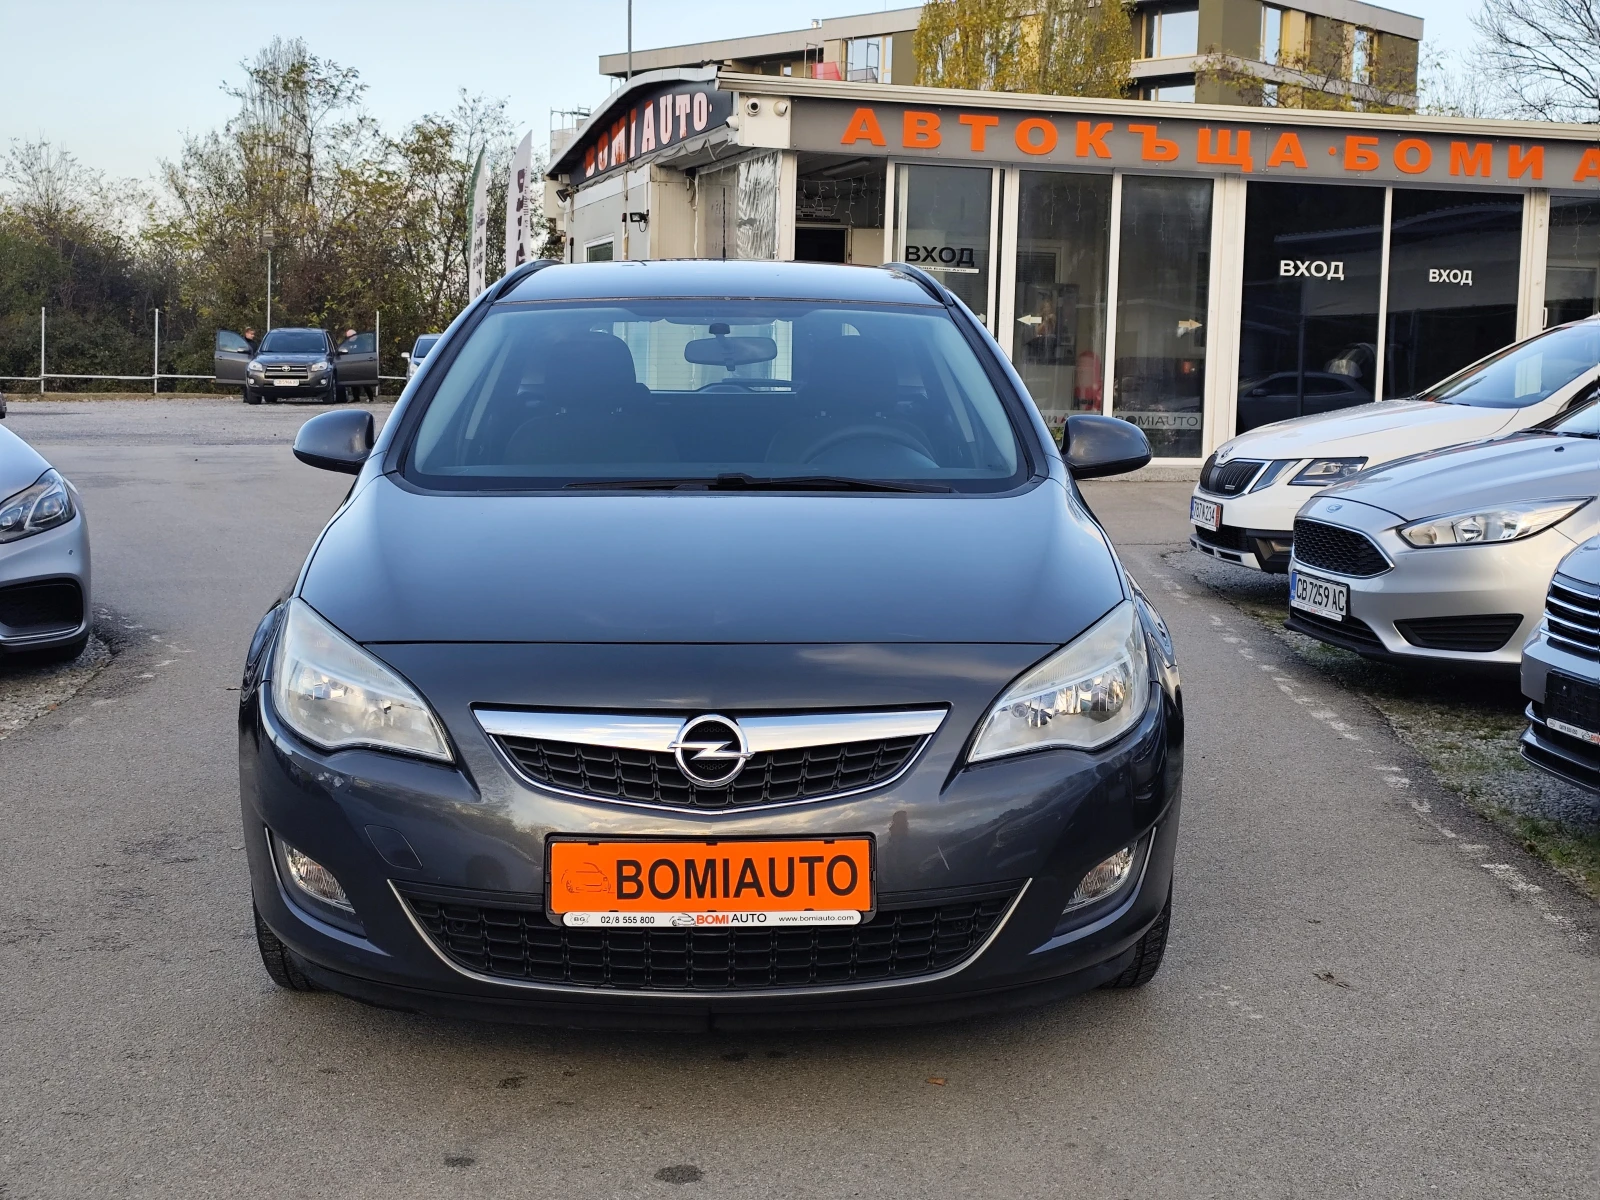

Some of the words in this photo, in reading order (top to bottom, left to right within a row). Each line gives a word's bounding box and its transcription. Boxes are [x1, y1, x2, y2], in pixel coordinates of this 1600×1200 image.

[840, 107, 1309, 173] АВТОКЪЩА
[1344, 135, 1545, 180] БОМИ
[905, 246, 975, 267] ВХОД
[1279, 260, 1345, 281] ВХОД
[1428, 269, 1473, 286] ВХОД
[1308, 582, 1330, 607] 7259
[1332, 588, 1345, 611] AC
[616, 854, 858, 900] BOMIAUTO
[600, 916, 620, 924] 02/8
[622, 915, 638, 924] 555
[639, 915, 655, 924] 800
[696, 914, 729, 925] BOMI
[731, 913, 767, 923] AUTO
[778, 914, 854, 922] www.bomiauto.com
